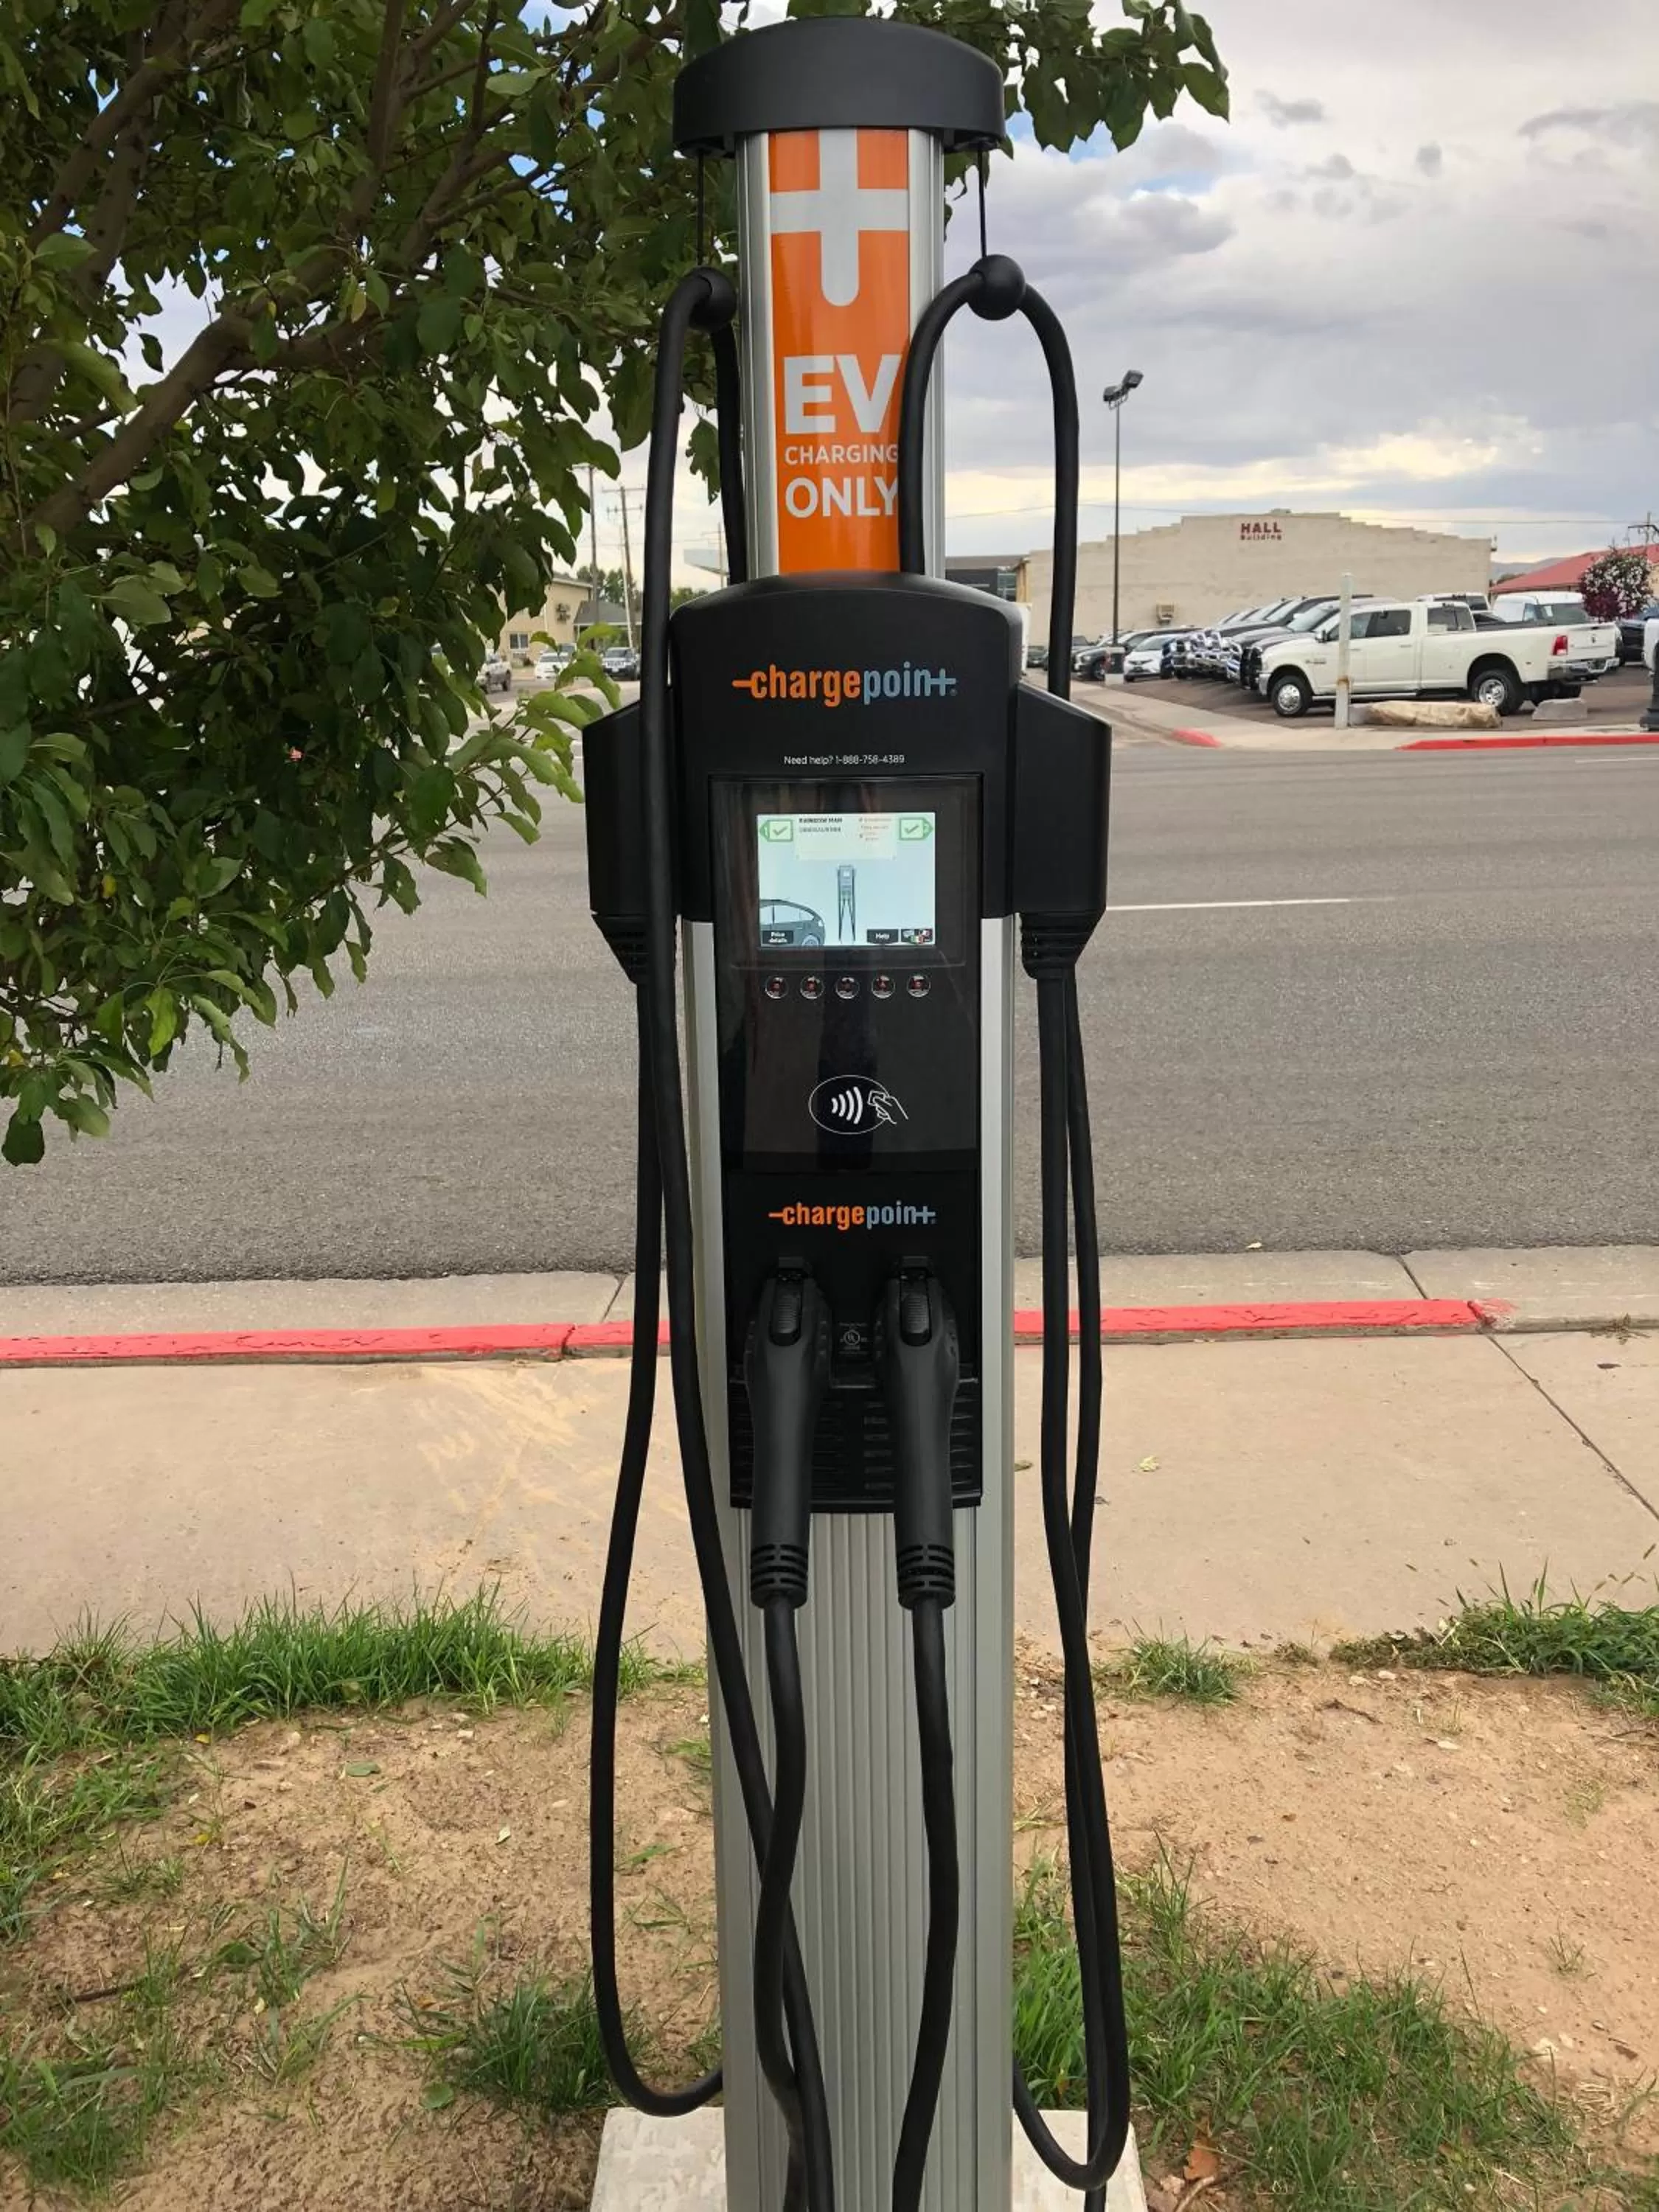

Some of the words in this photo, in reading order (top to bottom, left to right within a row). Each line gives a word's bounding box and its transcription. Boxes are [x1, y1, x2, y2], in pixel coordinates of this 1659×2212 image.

[783, 354, 903, 435] EV
[785, 444, 898, 466] CHARGING
[785, 476, 898, 518] ONLY
[1241, 521, 1281, 533] HALL
[784, 756, 807, 765] Need
[809, 755, 833, 765] help?
